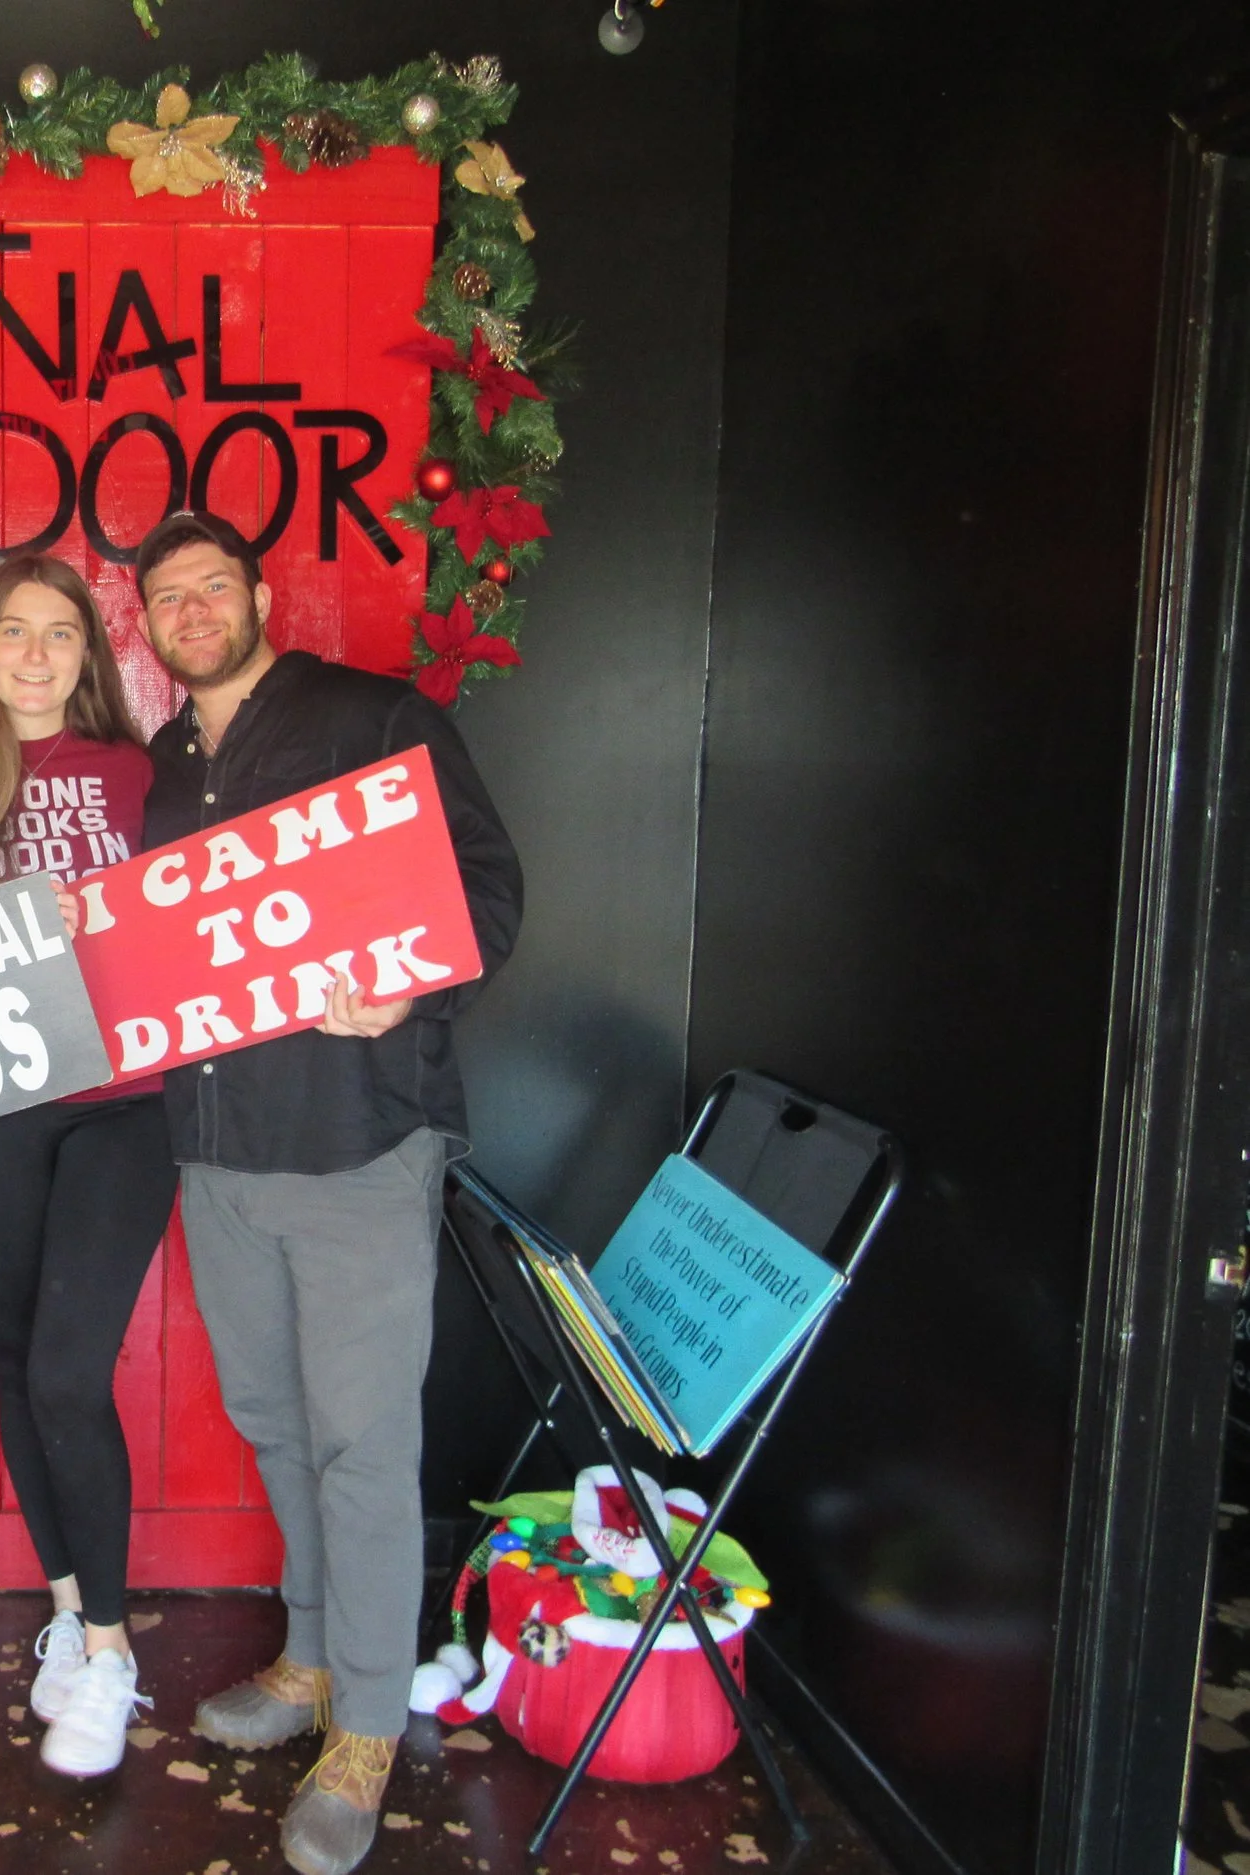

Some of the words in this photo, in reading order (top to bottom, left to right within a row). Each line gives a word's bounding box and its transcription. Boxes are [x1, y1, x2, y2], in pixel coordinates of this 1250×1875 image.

[22, 776, 107, 810] ONE
[80, 881, 116, 935] I
[141, 764, 419, 907] CAME
[87, 832, 130, 866] IN
[196, 889, 312, 968] TO
[115, 925, 452, 1072] DRINK
[649, 1227, 678, 1262] the
[670, 1246, 726, 1302] Power
[718, 1294, 751, 1321] of
[651, 1172, 694, 1219] Never
[687, 1203, 809, 1312] Underestimate
[618, 1256, 669, 1312] Stupid
[656, 1293, 708, 1354] People
[699, 1335, 723, 1370] in
